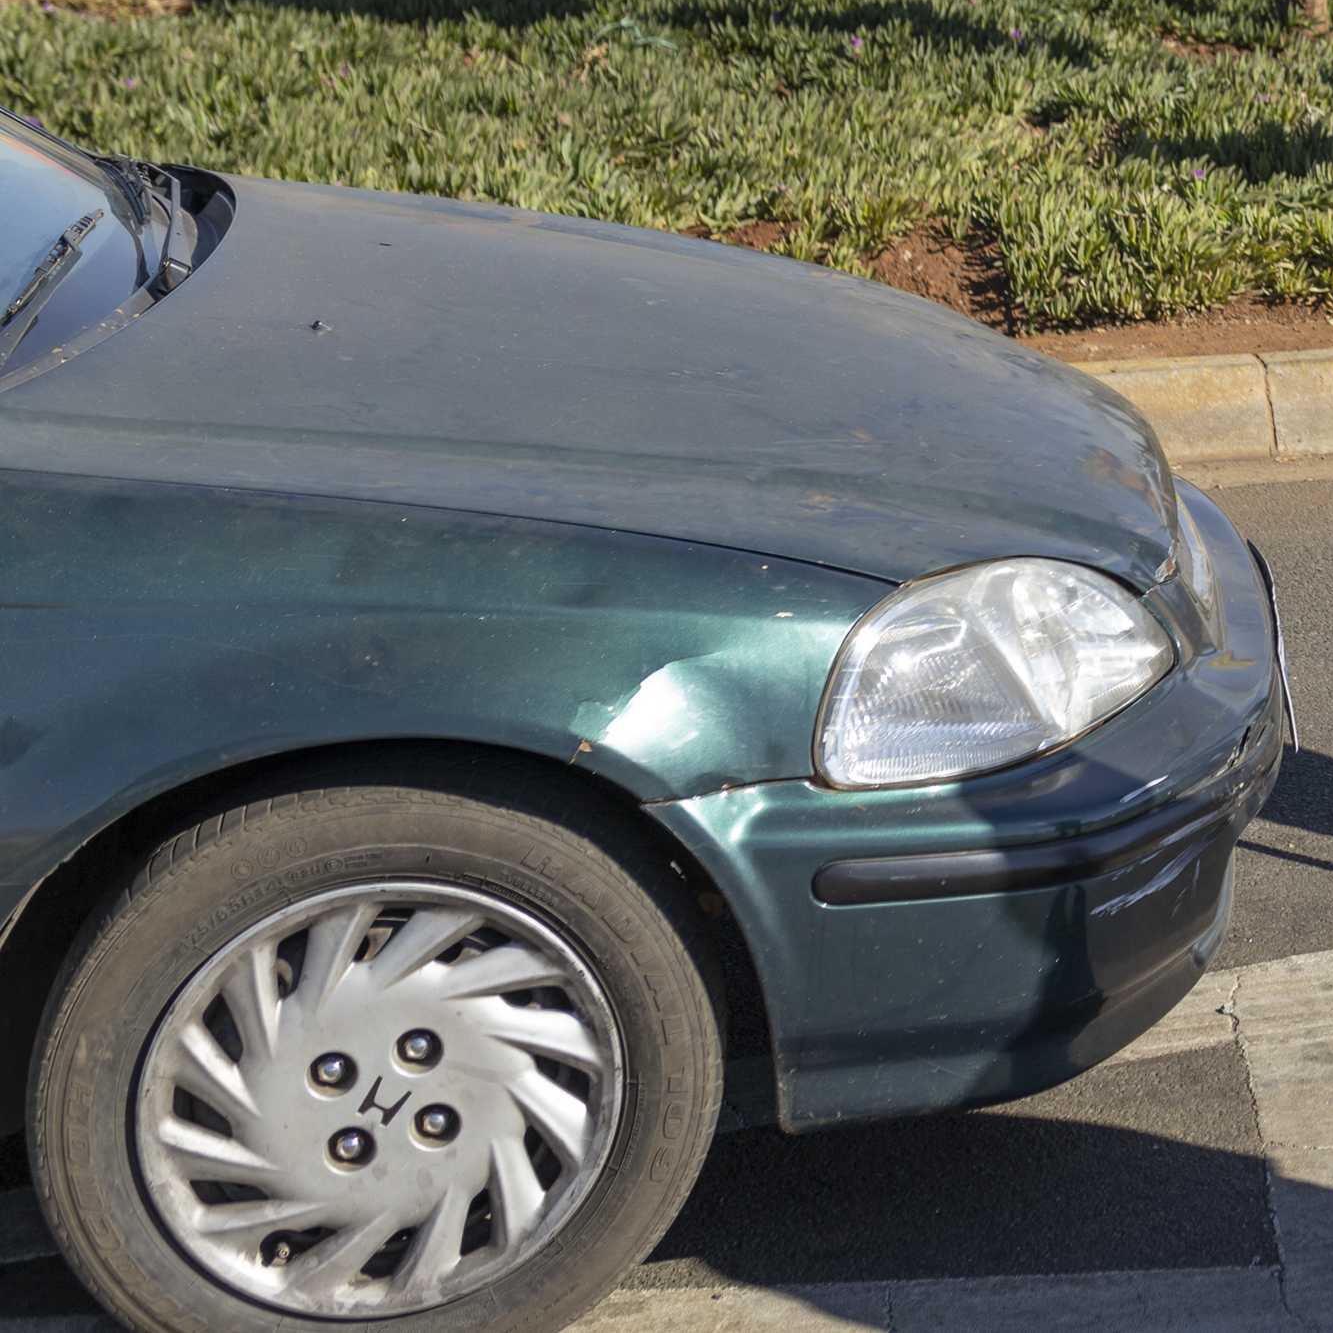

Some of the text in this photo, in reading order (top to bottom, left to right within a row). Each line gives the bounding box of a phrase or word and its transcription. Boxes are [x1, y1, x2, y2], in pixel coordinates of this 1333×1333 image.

[500, 870, 560, 907] TUBELESS
[520, 846, 690, 1184] RADIAL 109
